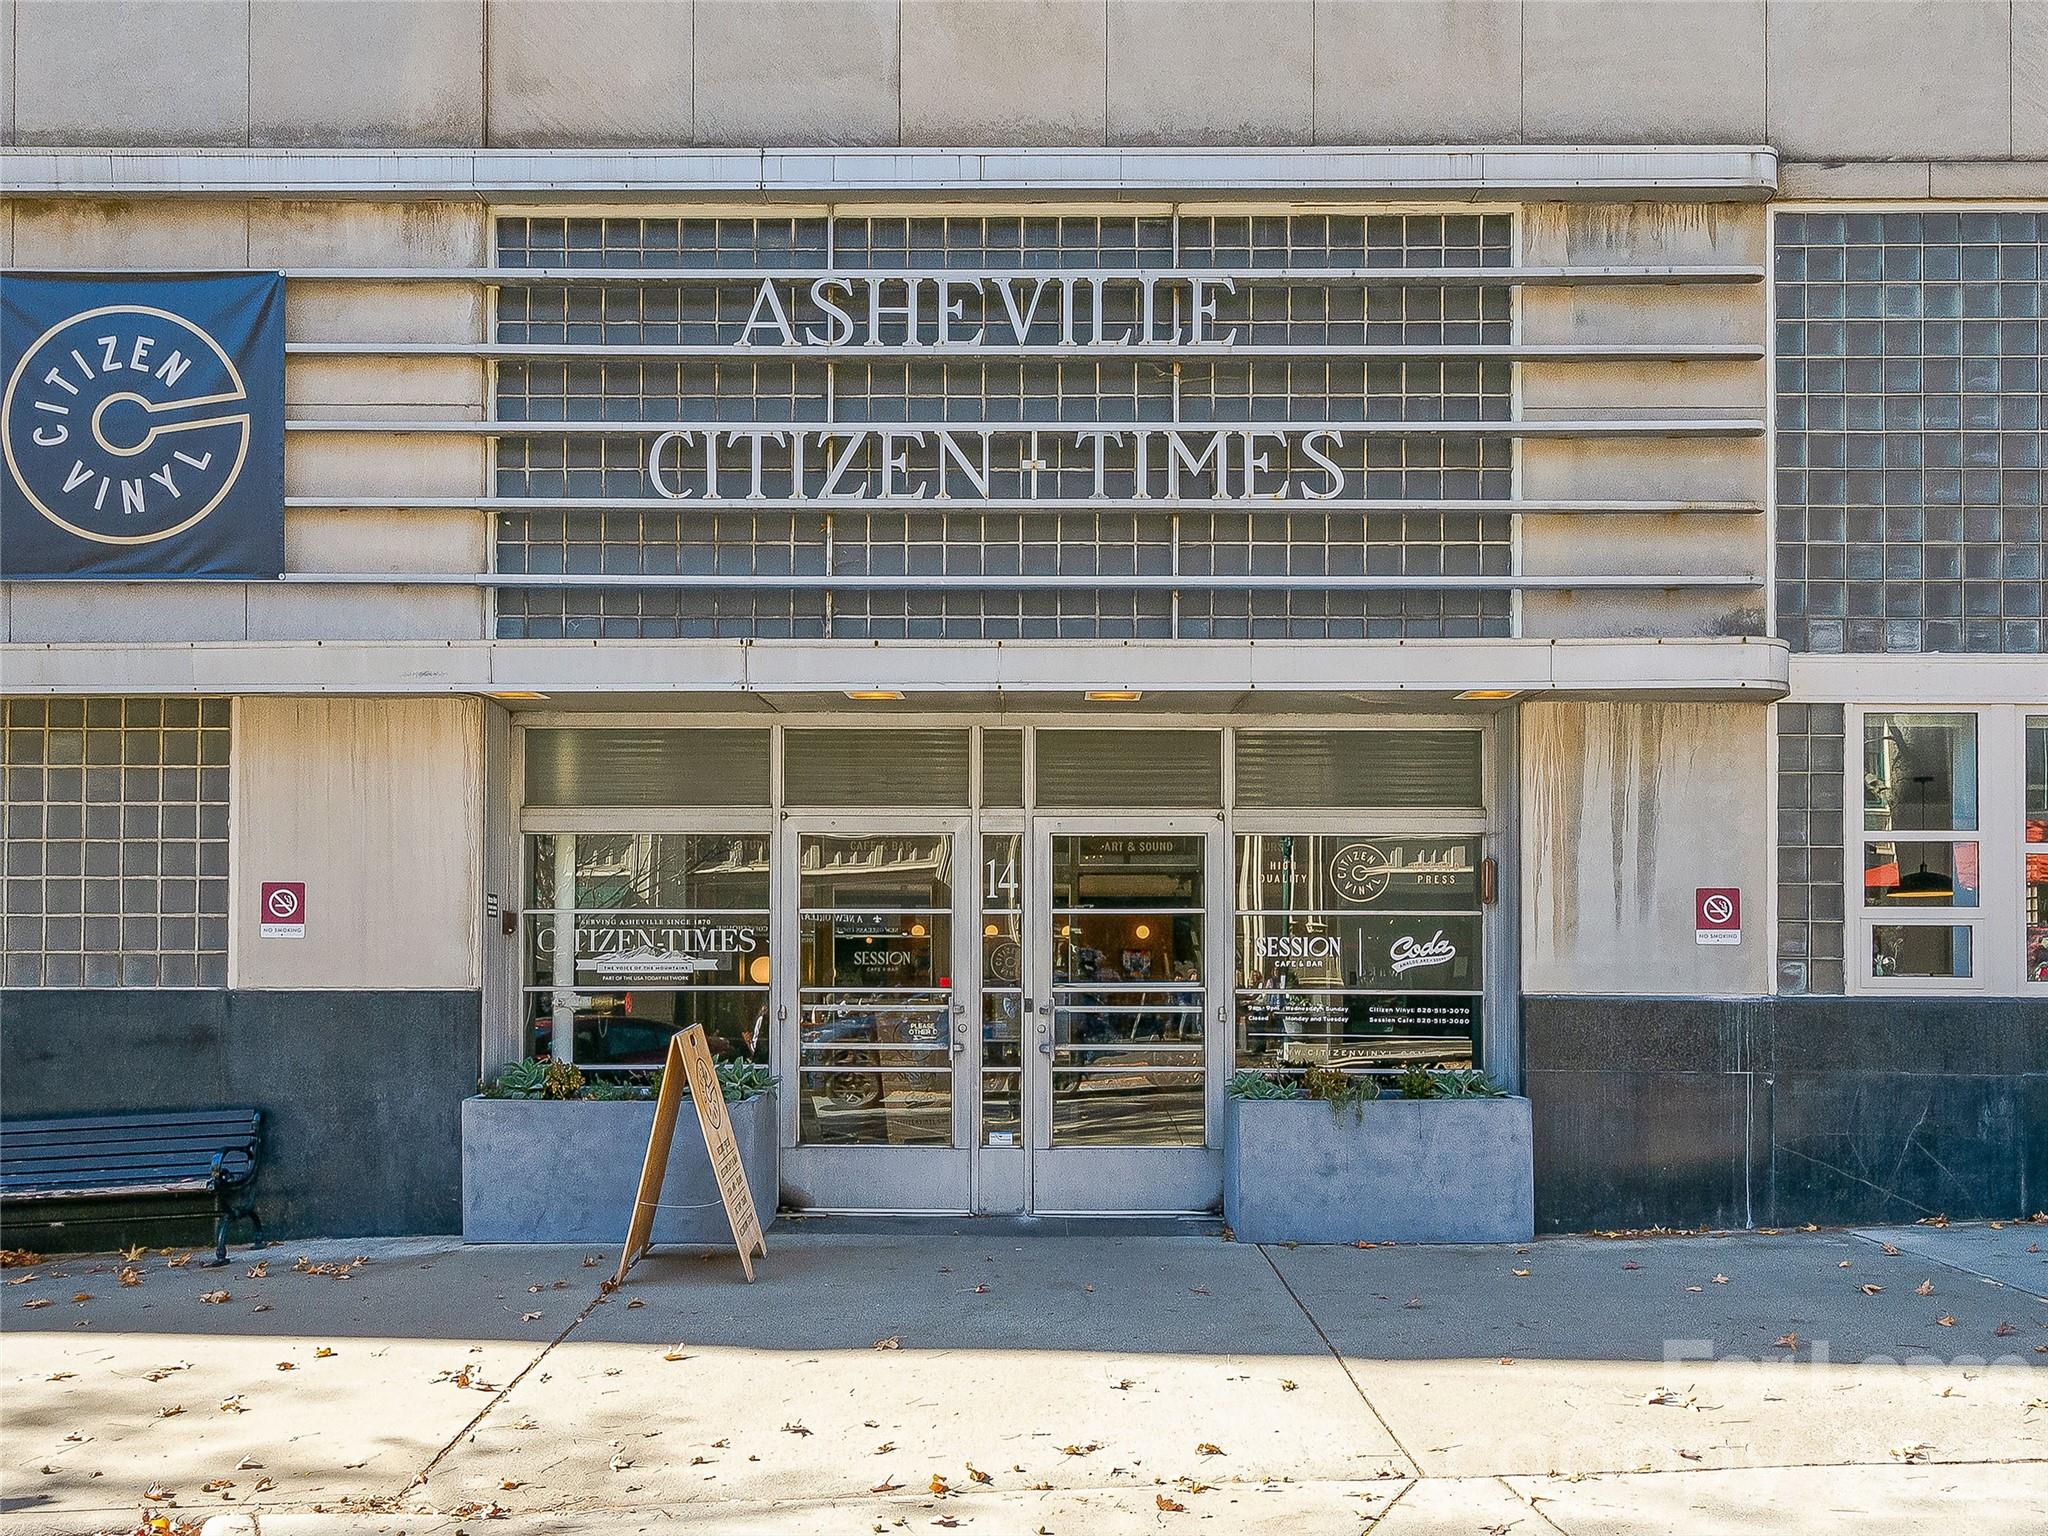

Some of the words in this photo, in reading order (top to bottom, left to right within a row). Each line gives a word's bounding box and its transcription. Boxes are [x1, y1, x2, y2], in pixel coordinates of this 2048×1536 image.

[733, 276, 1238, 347] ASHEVILLE
[32, 335, 192, 446] CITIZEN
[648, 430, 997, 500] CITIZEN
[1075, 430, 1346, 500] TIMES
[62, 450, 213, 514] VINYL
[1104, 841, 1123, 851] ART
[1127, 841, 1136, 851] &
[1140, 841, 1173, 851] SOUND
[1337, 851, 1376, 879] CITIZEN
[986, 859, 1019, 898] 14
[1344, 879, 1381, 895] VINYL
[1417, 875, 1455, 884] PRESS
[537, 928, 756, 953] CTIZEN-TIMES
[1256, 936, 1341, 958] SESSION
[1390, 930, 1451, 961] Coda
[853, 951, 911, 965] SESSION
[1275, 960, 1297, 968] CAFE
[1299, 960, 1305, 968] &
[1306, 960, 1323, 968] BAR
[1285, 1015, 1309, 1023] Monday
